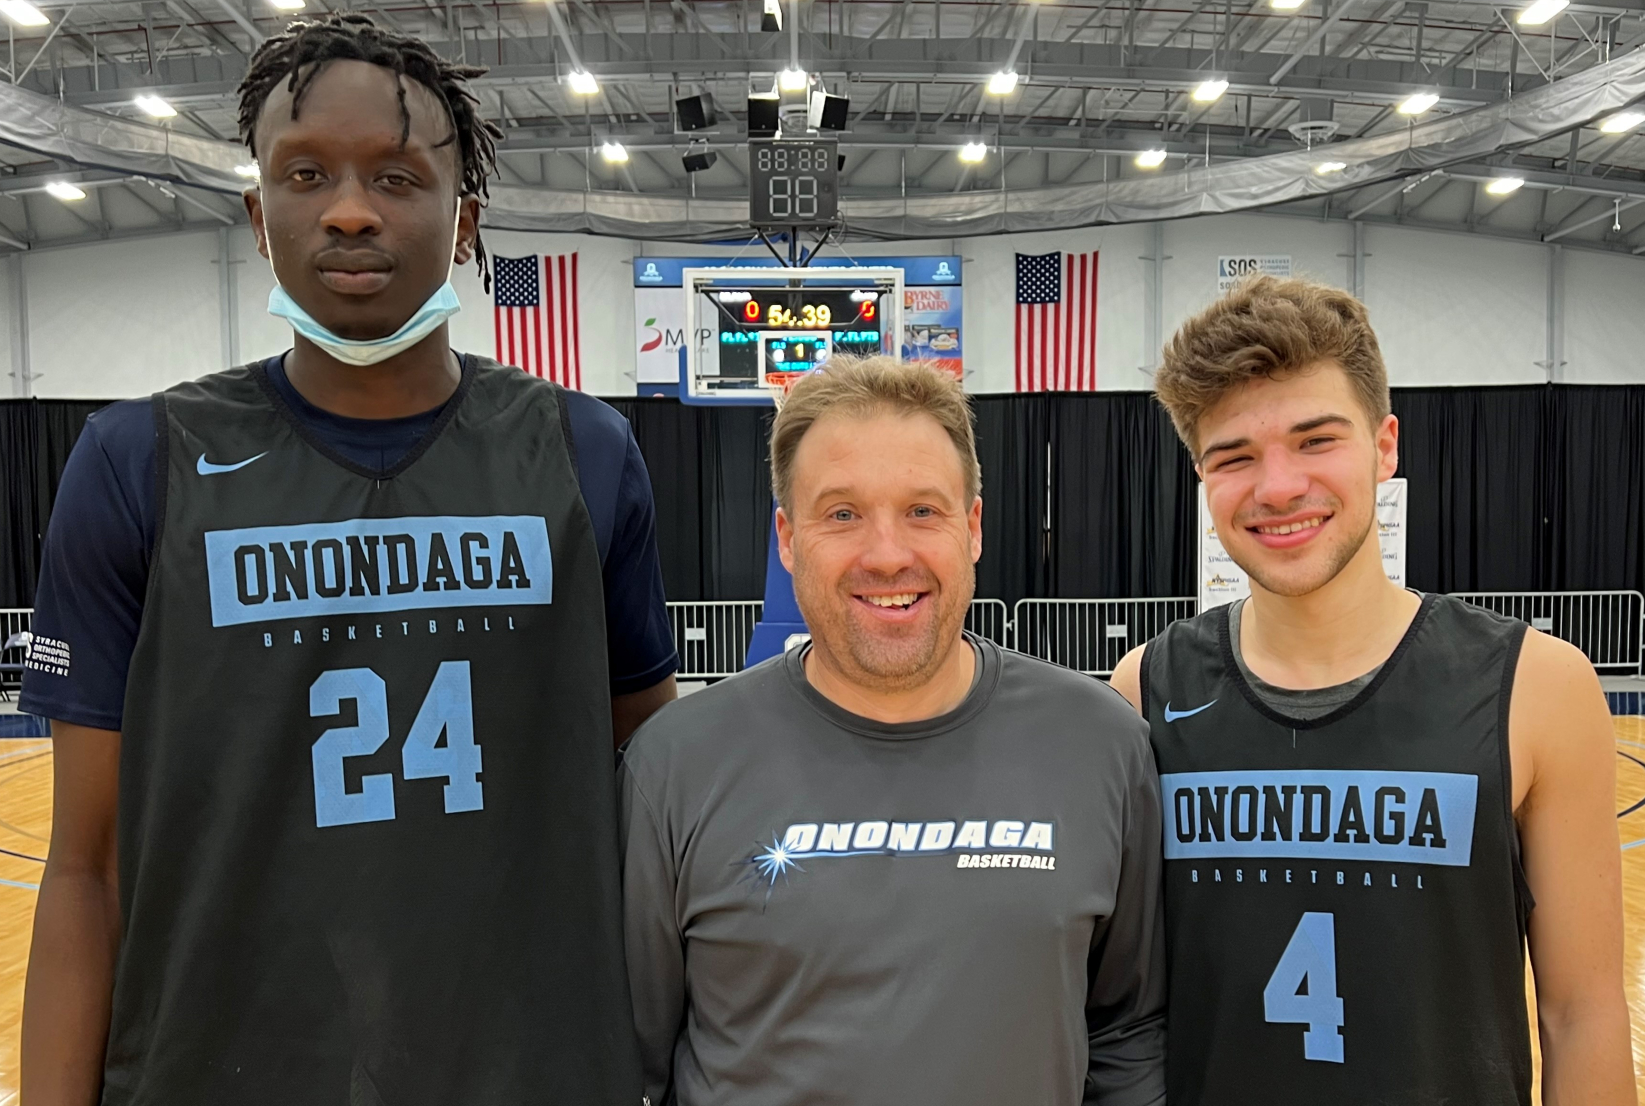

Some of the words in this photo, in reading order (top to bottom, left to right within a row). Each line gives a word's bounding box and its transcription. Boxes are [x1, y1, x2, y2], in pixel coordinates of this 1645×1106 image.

[1228, 258, 1257, 277] SOS
[904, 289, 945, 304] BYRNE
[916, 300, 950, 311] DAIRY
[665, 328, 711, 346] MP
[795, 343, 804, 358] 1
[234, 531, 531, 606] ONONDAGA
[263, 616, 516, 648] BASKETBALL
[309, 660, 484, 828] 24
[1174, 785, 1447, 849] ONONDAGA
[784, 820, 1055, 852] ONONDAGA
[956, 853, 1057, 871] BASKETBALL
[1190, 868, 1425, 890] BASKETBALL
[1263, 911, 1345, 1064] 4
